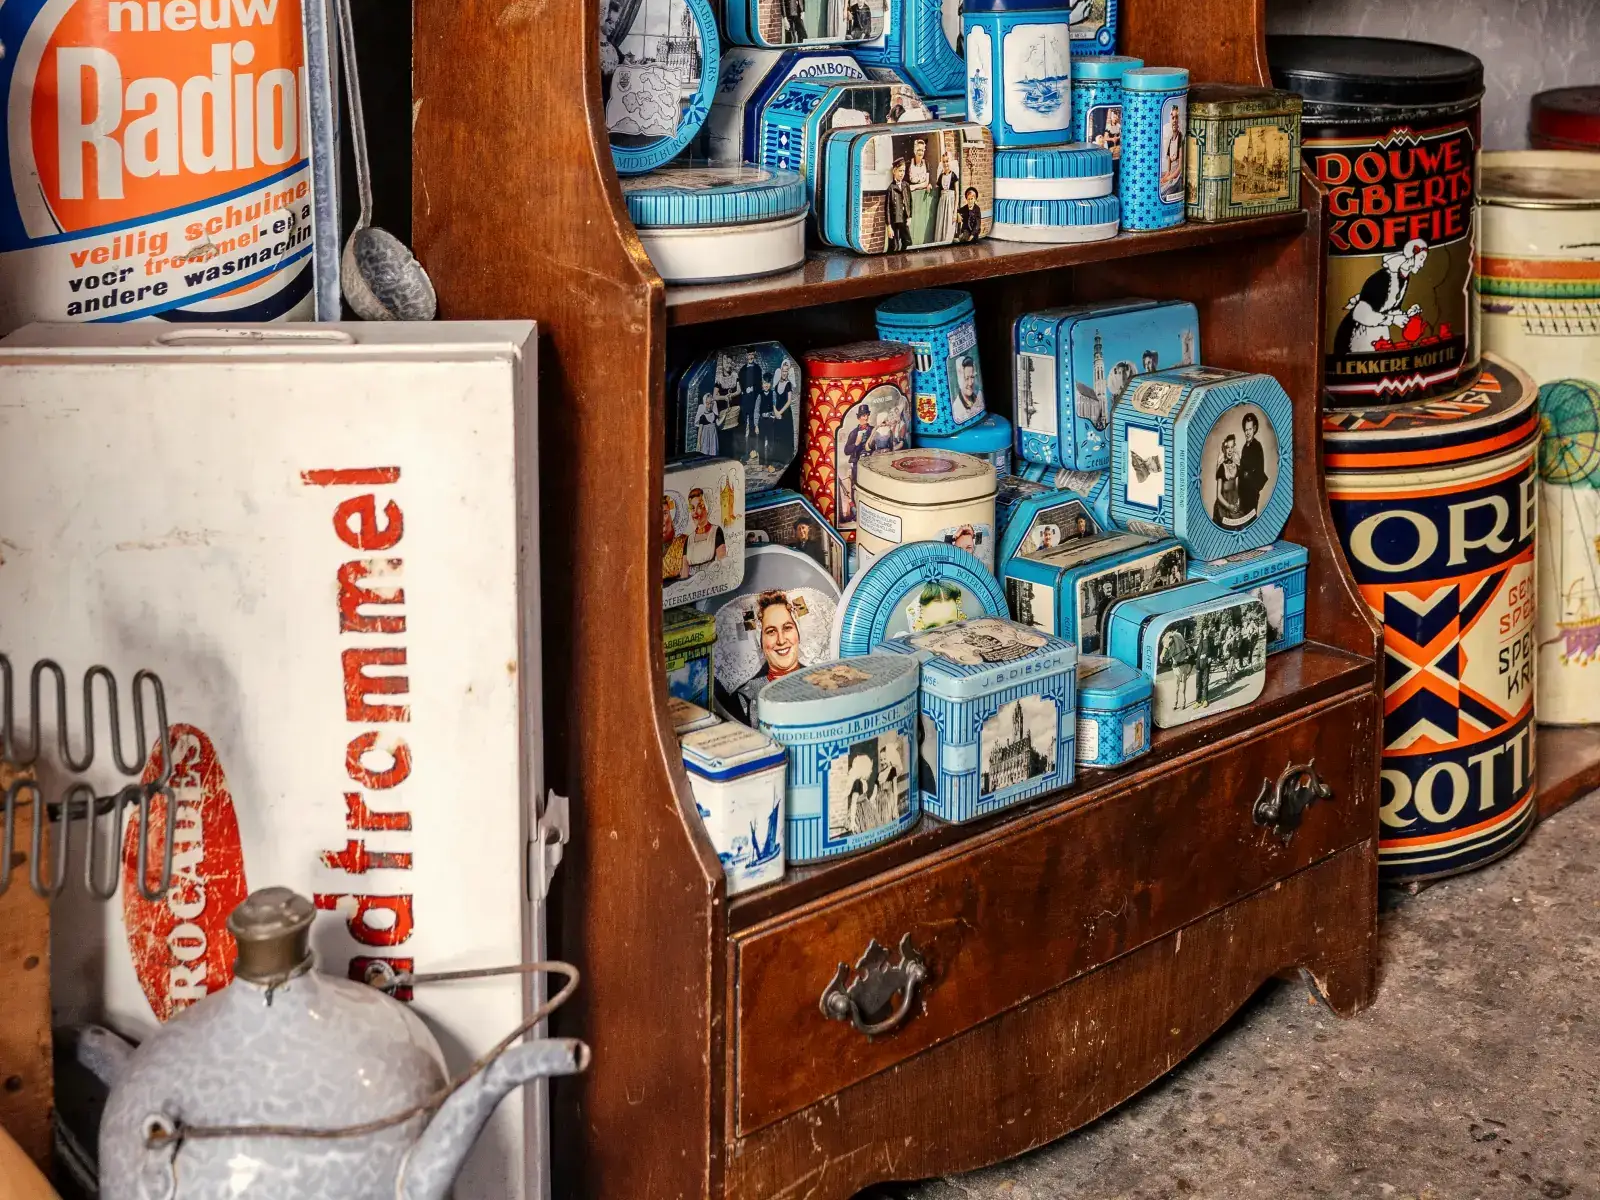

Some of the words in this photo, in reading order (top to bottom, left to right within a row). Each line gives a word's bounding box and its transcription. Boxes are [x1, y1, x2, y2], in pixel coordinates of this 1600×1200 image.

[790, 62, 863, 80] OOMBOTER
[56, 42, 309, 201] Radio
[616, 132, 688, 170] MIDDELBURG
[1315, 138, 1464, 185] DOUWE
[69, 231, 168, 269] veilig
[184, 180, 311, 244] schuime
[68, 266, 134, 293] voor
[66, 281, 168, 317] andere
[1335, 356, 1411, 375] LEKKERE
[881, 579, 910, 617] ZEEUWSE
[772, 726, 844, 741] MIDDELBURG
[1379, 718, 1536, 828] ROTT
